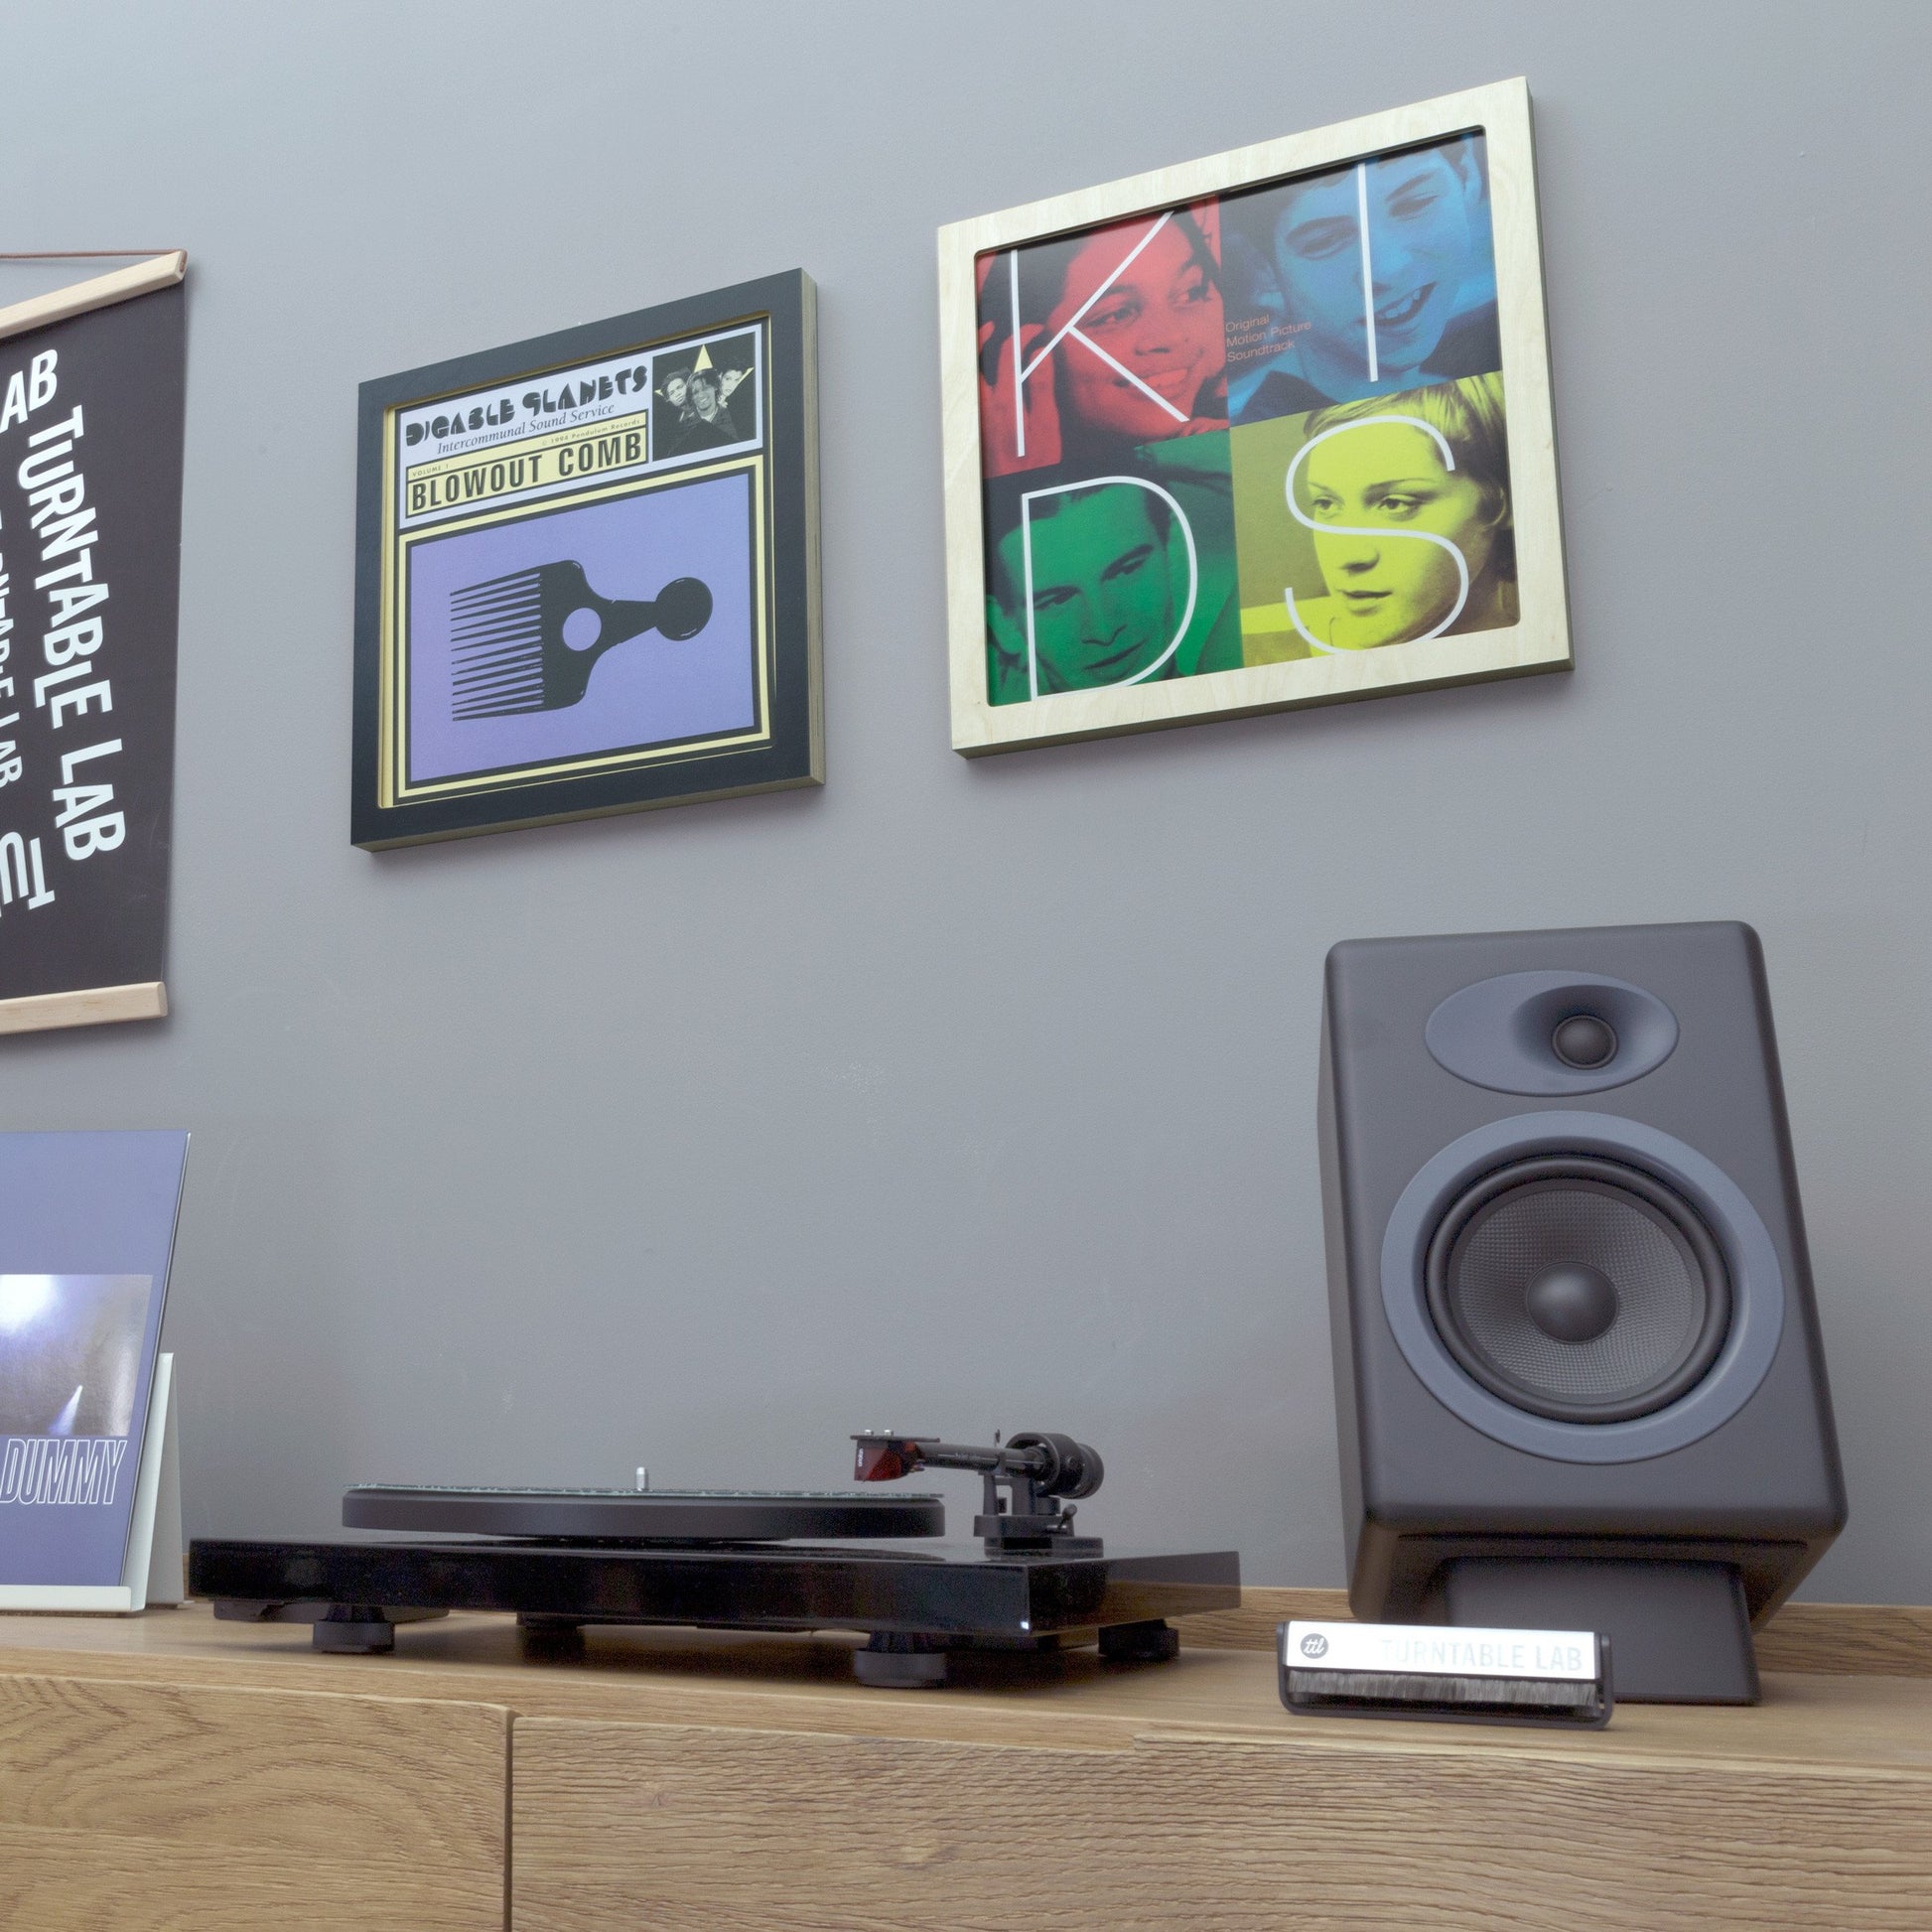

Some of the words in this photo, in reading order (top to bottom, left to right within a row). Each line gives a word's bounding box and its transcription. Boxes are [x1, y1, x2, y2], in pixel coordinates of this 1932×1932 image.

[1226, 314, 1270, 332] Original
[1226, 331, 1266, 347] Motion
[1271, 321, 1311, 336] Picture
[1227, 339, 1295, 362] Soundtrack
[437, 421, 526, 454] Intercommunal
[528, 412, 567, 433] Sound
[570, 404, 615, 423] Service
[611, 418, 640, 430] Records
[412, 455, 542, 510] BLOWOUT
[558, 432, 641, 476] COMB
[412, 466, 442, 478] VOLUME
[18, 404, 114, 730] TURNTABLE
[53, 738, 126, 862] LAB
[0, 1438, 128, 1505] DUMMY
[1381, 1639, 1526, 1669] TURNTABLE
[1535, 1644, 1584, 1672] LAB
